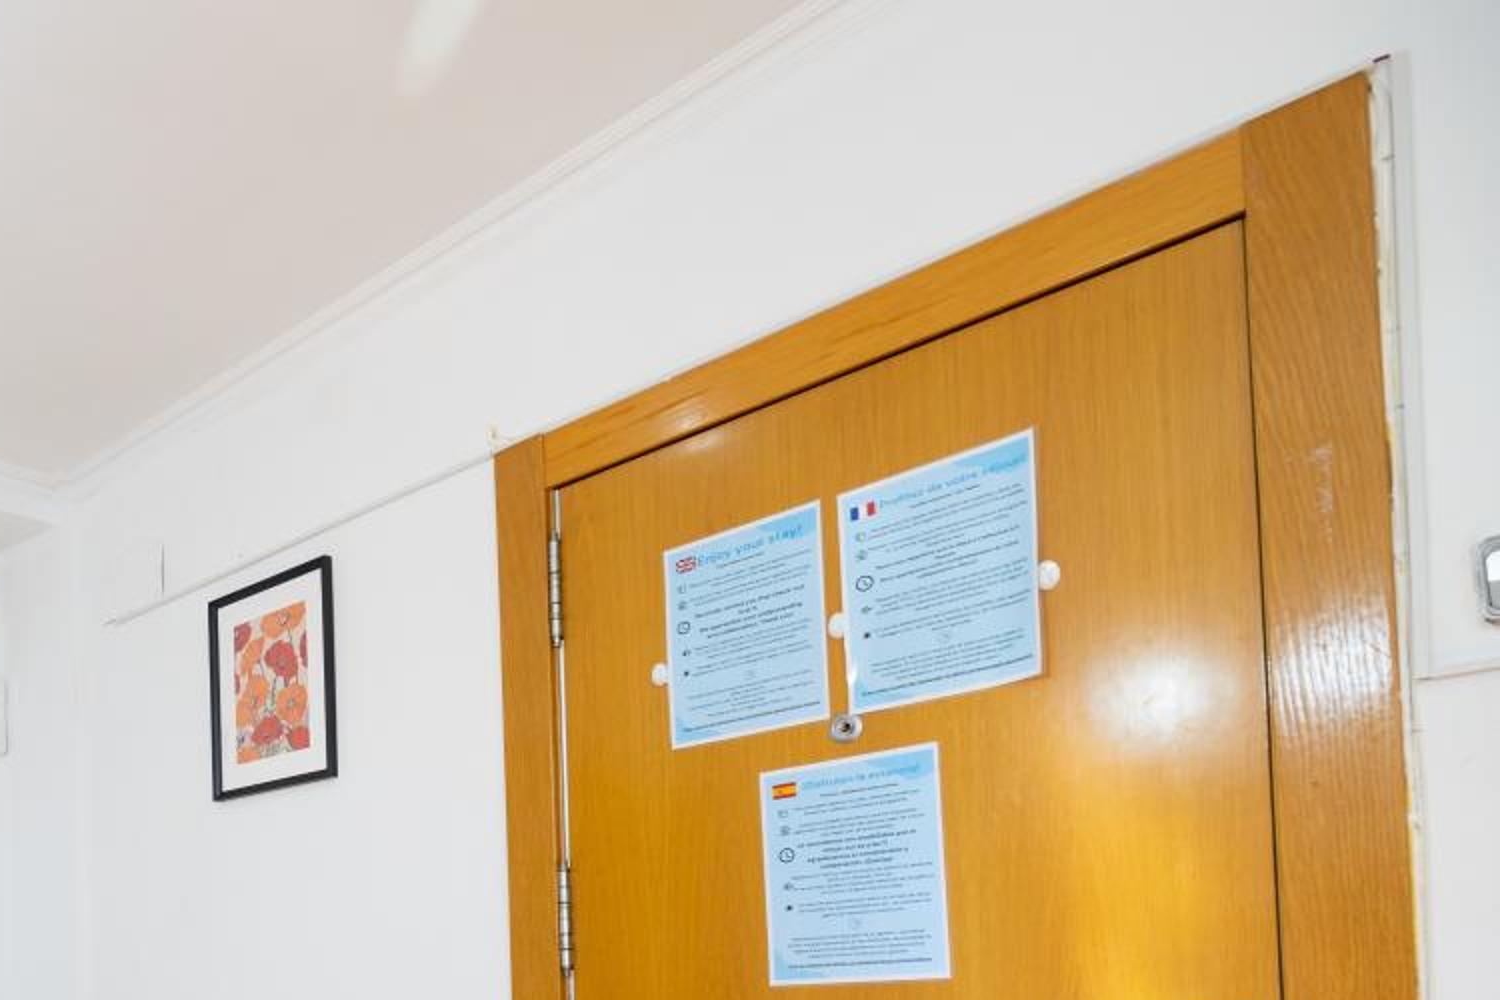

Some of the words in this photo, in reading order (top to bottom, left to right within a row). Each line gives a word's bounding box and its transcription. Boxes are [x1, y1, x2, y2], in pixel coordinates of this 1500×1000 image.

[697, 548, 732, 566] Enjoy
[735, 538, 765, 557] your
[768, 524, 803, 545] stay!
